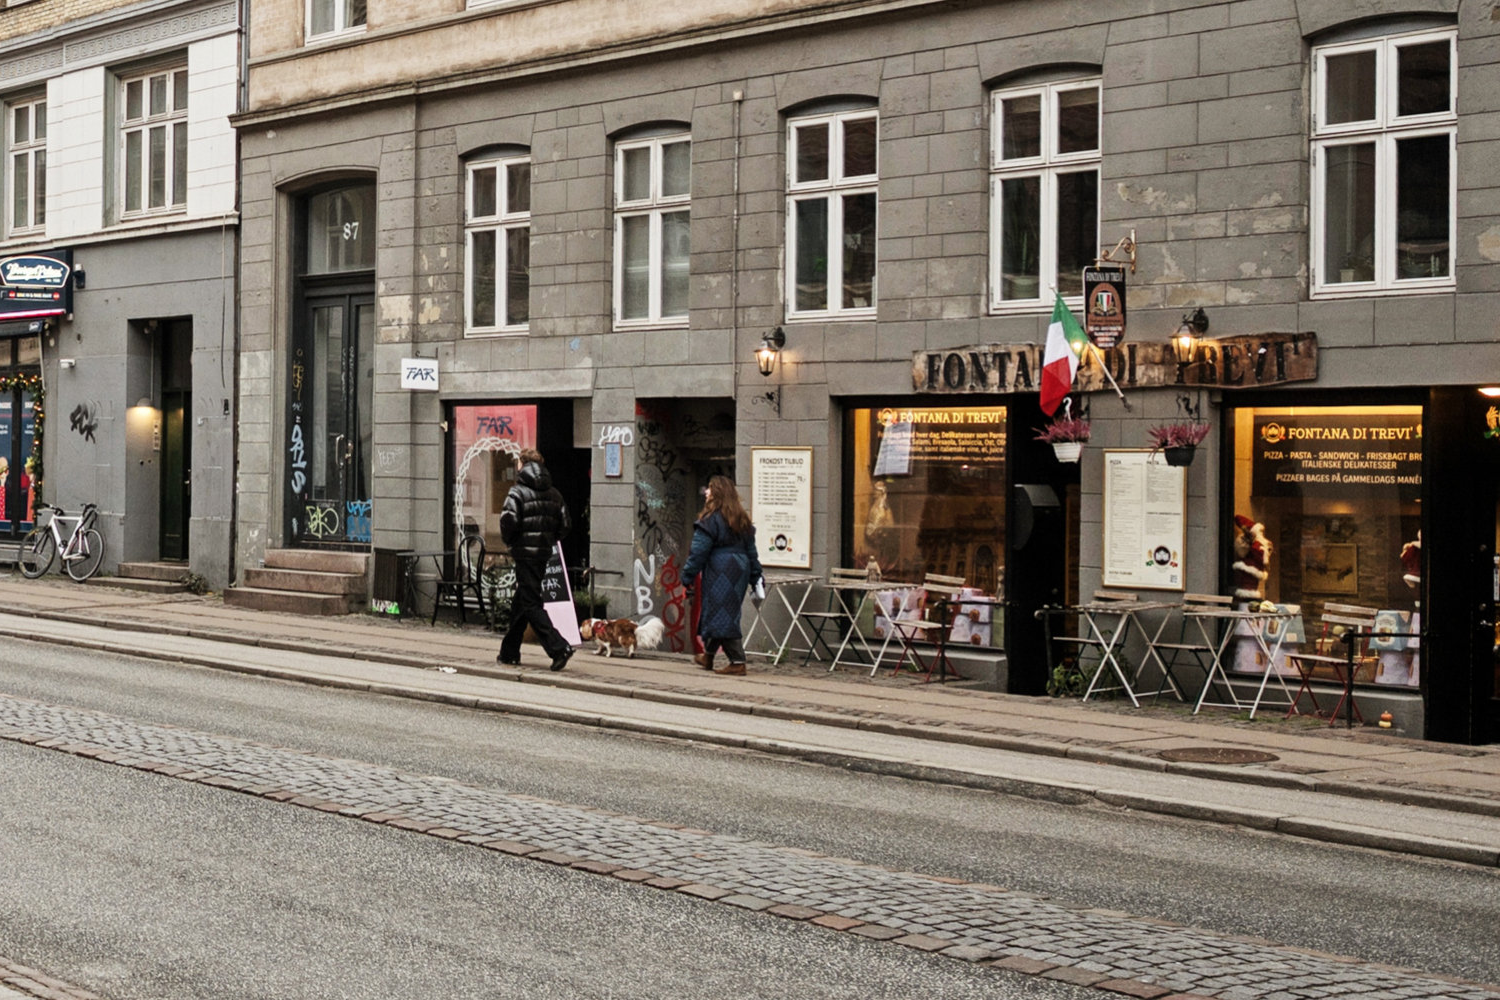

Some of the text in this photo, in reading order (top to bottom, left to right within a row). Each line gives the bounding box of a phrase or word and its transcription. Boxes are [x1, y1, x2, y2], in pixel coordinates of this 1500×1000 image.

[343, 222, 359, 240] 87
[407, 367, 436, 381] FAR
[927, 352, 1078, 390] FONTA
[900, 412, 949, 424] FONTANA
[952, 412, 964, 424] DI
[477, 416, 513, 435] FAR
[1289, 428, 1350, 440] FONTANA
[1353, 428, 1367, 440] DI
[1264, 451, 1283, 459] PIZZA
[1290, 452, 1312, 460] PASTA
[1319, 452, 1359, 460] SANDWICH
[1366, 452, 1407, 461] FRISKBAGT
[1302, 461, 1397, 469] ITALIENSKE DELIKATESSER
[1276, 474, 1304, 482] PIZZAER
[1307, 475, 1330, 483] BAGES
[1331, 473, 1342, 483] PÅ
[1343, 475, 1395, 484] GAMMELDAGS
